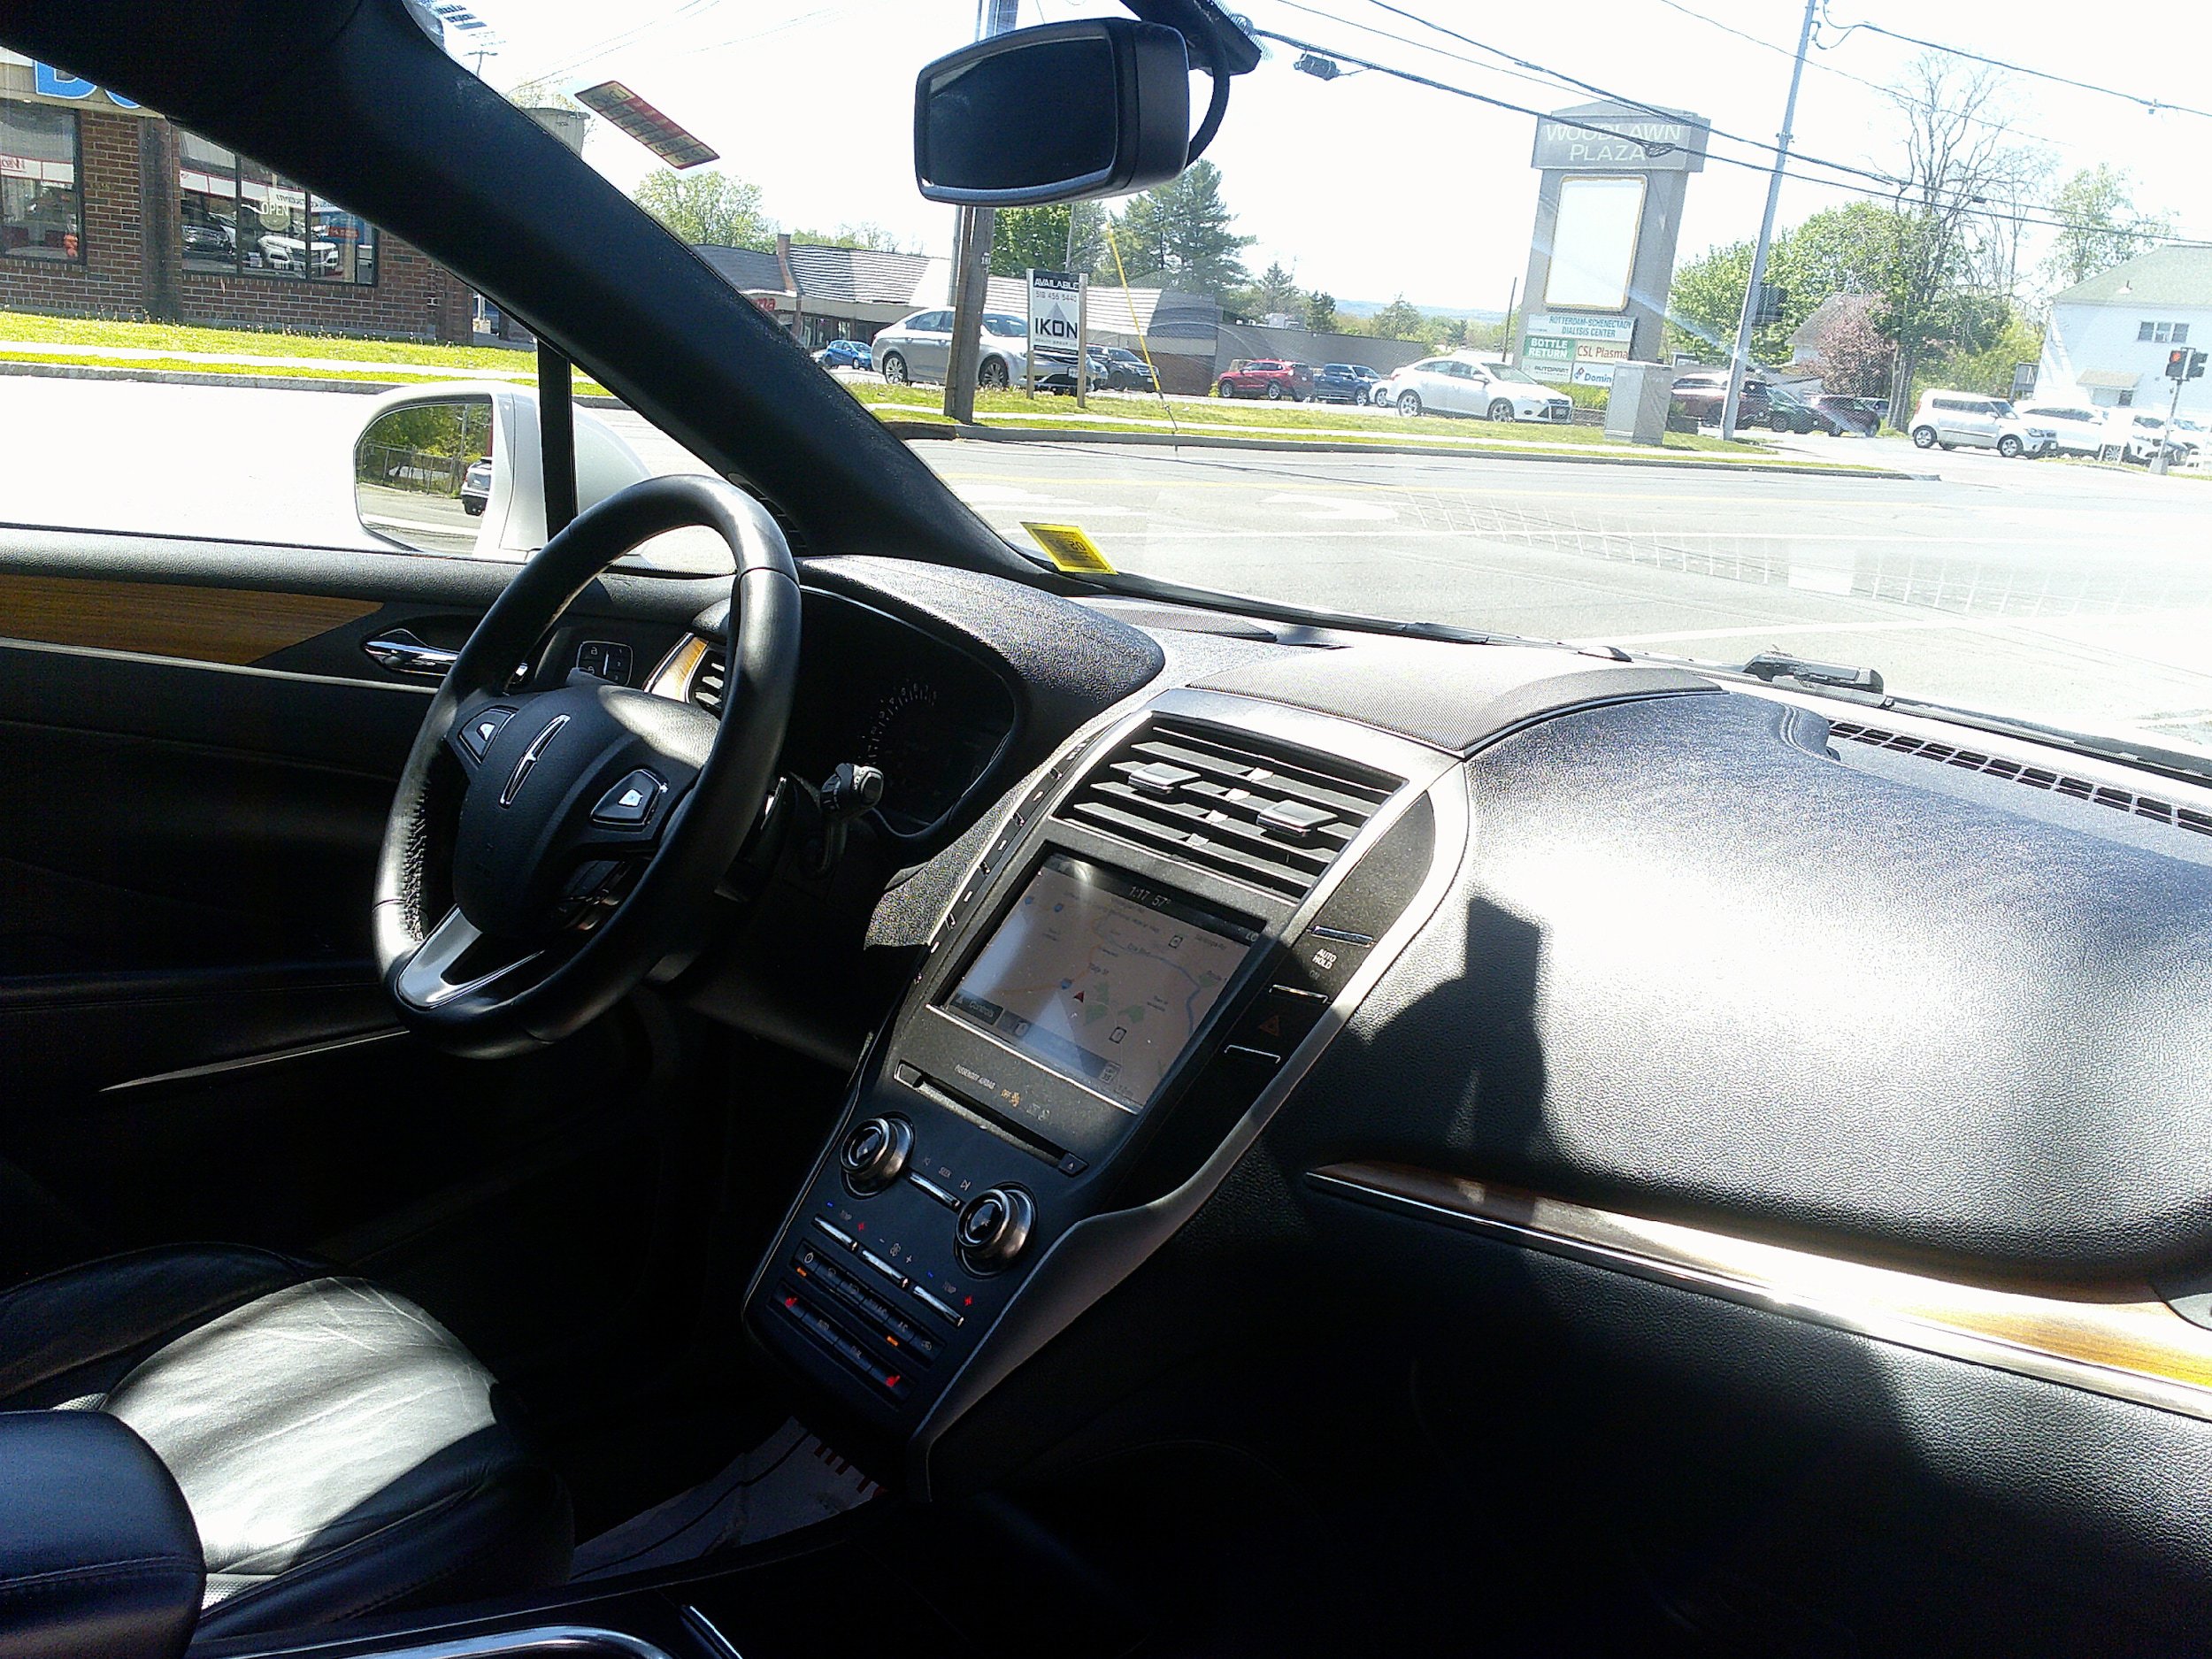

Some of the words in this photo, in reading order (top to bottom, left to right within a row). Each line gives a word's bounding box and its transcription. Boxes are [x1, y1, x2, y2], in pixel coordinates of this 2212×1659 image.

[1546, 123, 1681, 142] WOODLAWN
[1570, 143, 1647, 161] PLAZA
[261, 203, 288, 217] OPEN
[1033, 277, 1079, 291] AVAILABLE
[1035, 318, 1078, 340] IKON
[1562, 326, 1590, 336] DIALYSIS
[1590, 328, 1616, 338] CENTER
[1531, 337, 1568, 349] BOTTLE
[1528, 347, 1568, 358] RETURN
[1577, 345, 1593, 357] CSL
[1595, 346, 1629, 360] Plasma
[1129, 886, 1150, 901] 1:17
[1312, 955, 1333, 970] HOLD
[1317, 949, 1337, 963] AUTO
